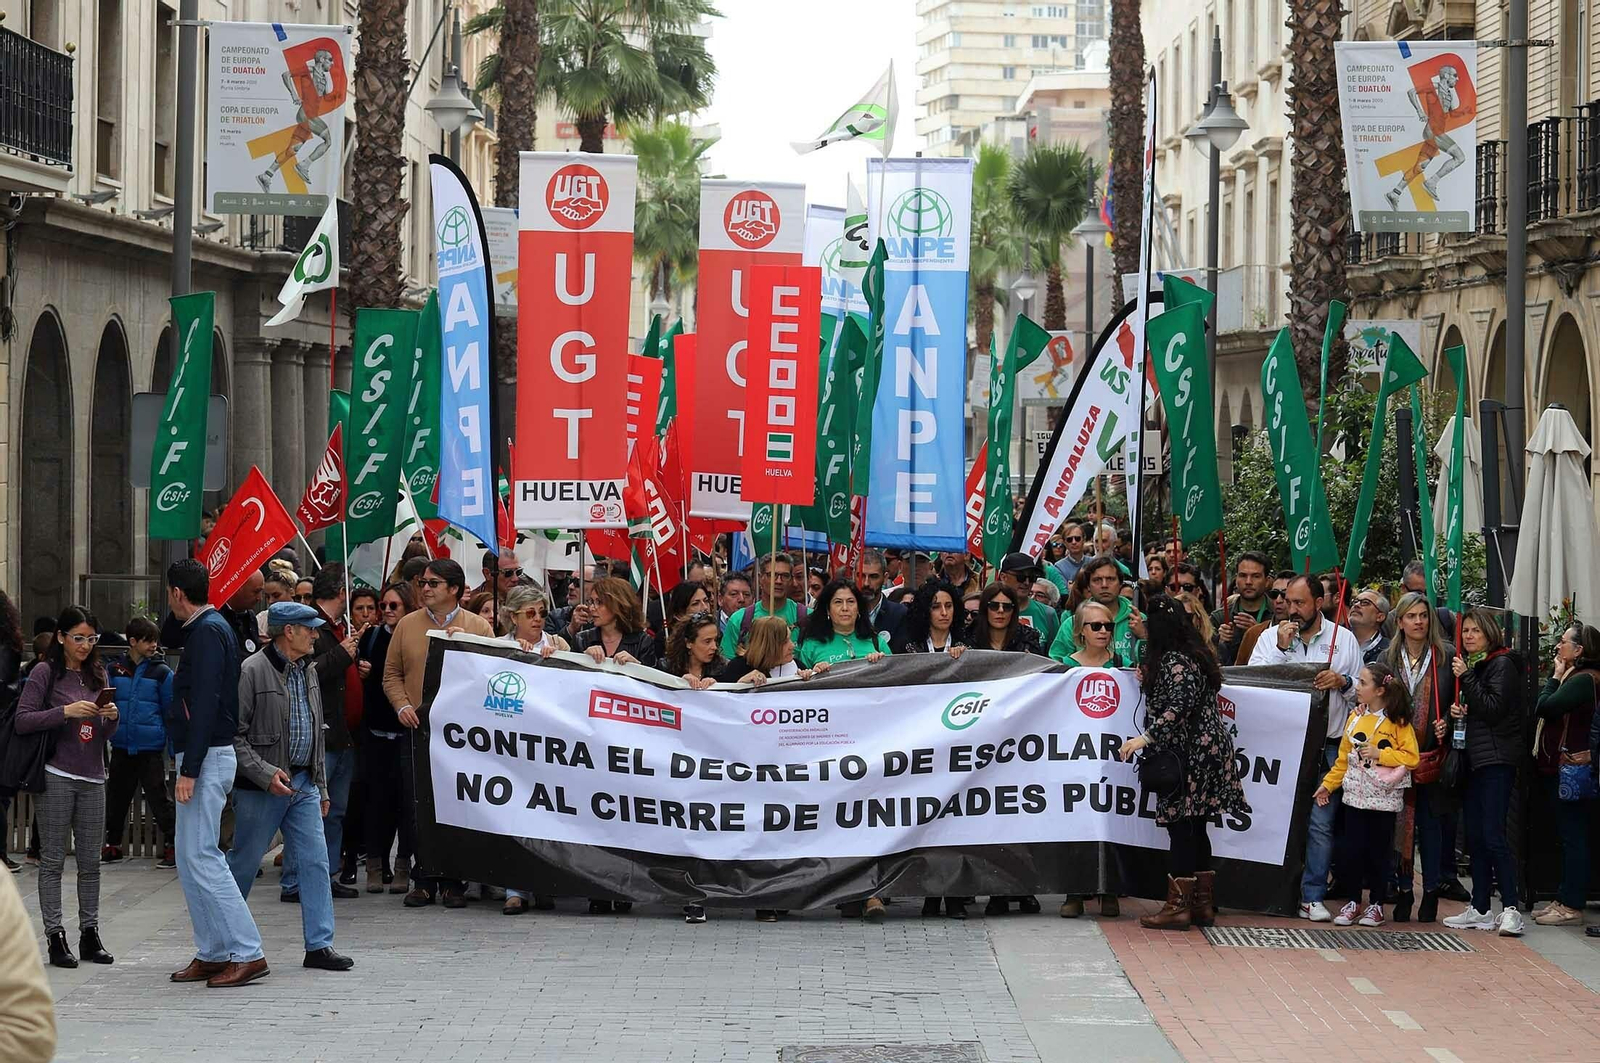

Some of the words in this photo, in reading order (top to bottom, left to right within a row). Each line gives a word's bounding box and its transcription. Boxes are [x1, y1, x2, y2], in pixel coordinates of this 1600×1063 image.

[221, 46, 270, 55] CAMPEONATO
[221, 56, 230, 64] DE
[221, 66, 231, 74] DE
[232, 66, 266, 75] DUATLÓN
[1346, 65, 1394, 73] CAMPEONATO
[1358, 84, 1391, 92] DUATLÓN
[220, 106, 239, 114] COPA
[240, 106, 250, 114] DE
[252, 106, 279, 115] EUROPA
[220, 116, 230, 124] DE
[232, 116, 266, 124] TRIATLÓN
[1378, 124, 1406, 132] EUROPA
[1359, 134, 1392, 142] TRIATLÓN
[554, 174, 600, 200] UGT
[730, 200, 773, 223] UGT
[886, 236, 956, 258] ANPE
[550, 253, 597, 460] UGT
[767, 285, 800, 427] CCOO
[893, 284, 941, 524] ANPE
[765, 468, 793, 478] HUELVA
[522, 481, 622, 502] HUELVA
[1082, 679, 1116, 696] UGT
[484, 696, 524, 712] ANPE
[594, 696, 661, 721] CCOO
[950, 698, 991, 717] CSIF
[442, 722, 595, 770] CONTRA
[608, 745, 654, 776] EL
[670, 752, 868, 782] DECRETO
[883, 748, 934, 778] DE
[456, 772, 513, 805] NO
[526, 782, 577, 816] AL
[590, 792, 746, 832] CIERRE
[763, 804, 820, 832] DE
[836, 784, 1046, 828] UNIDADES
